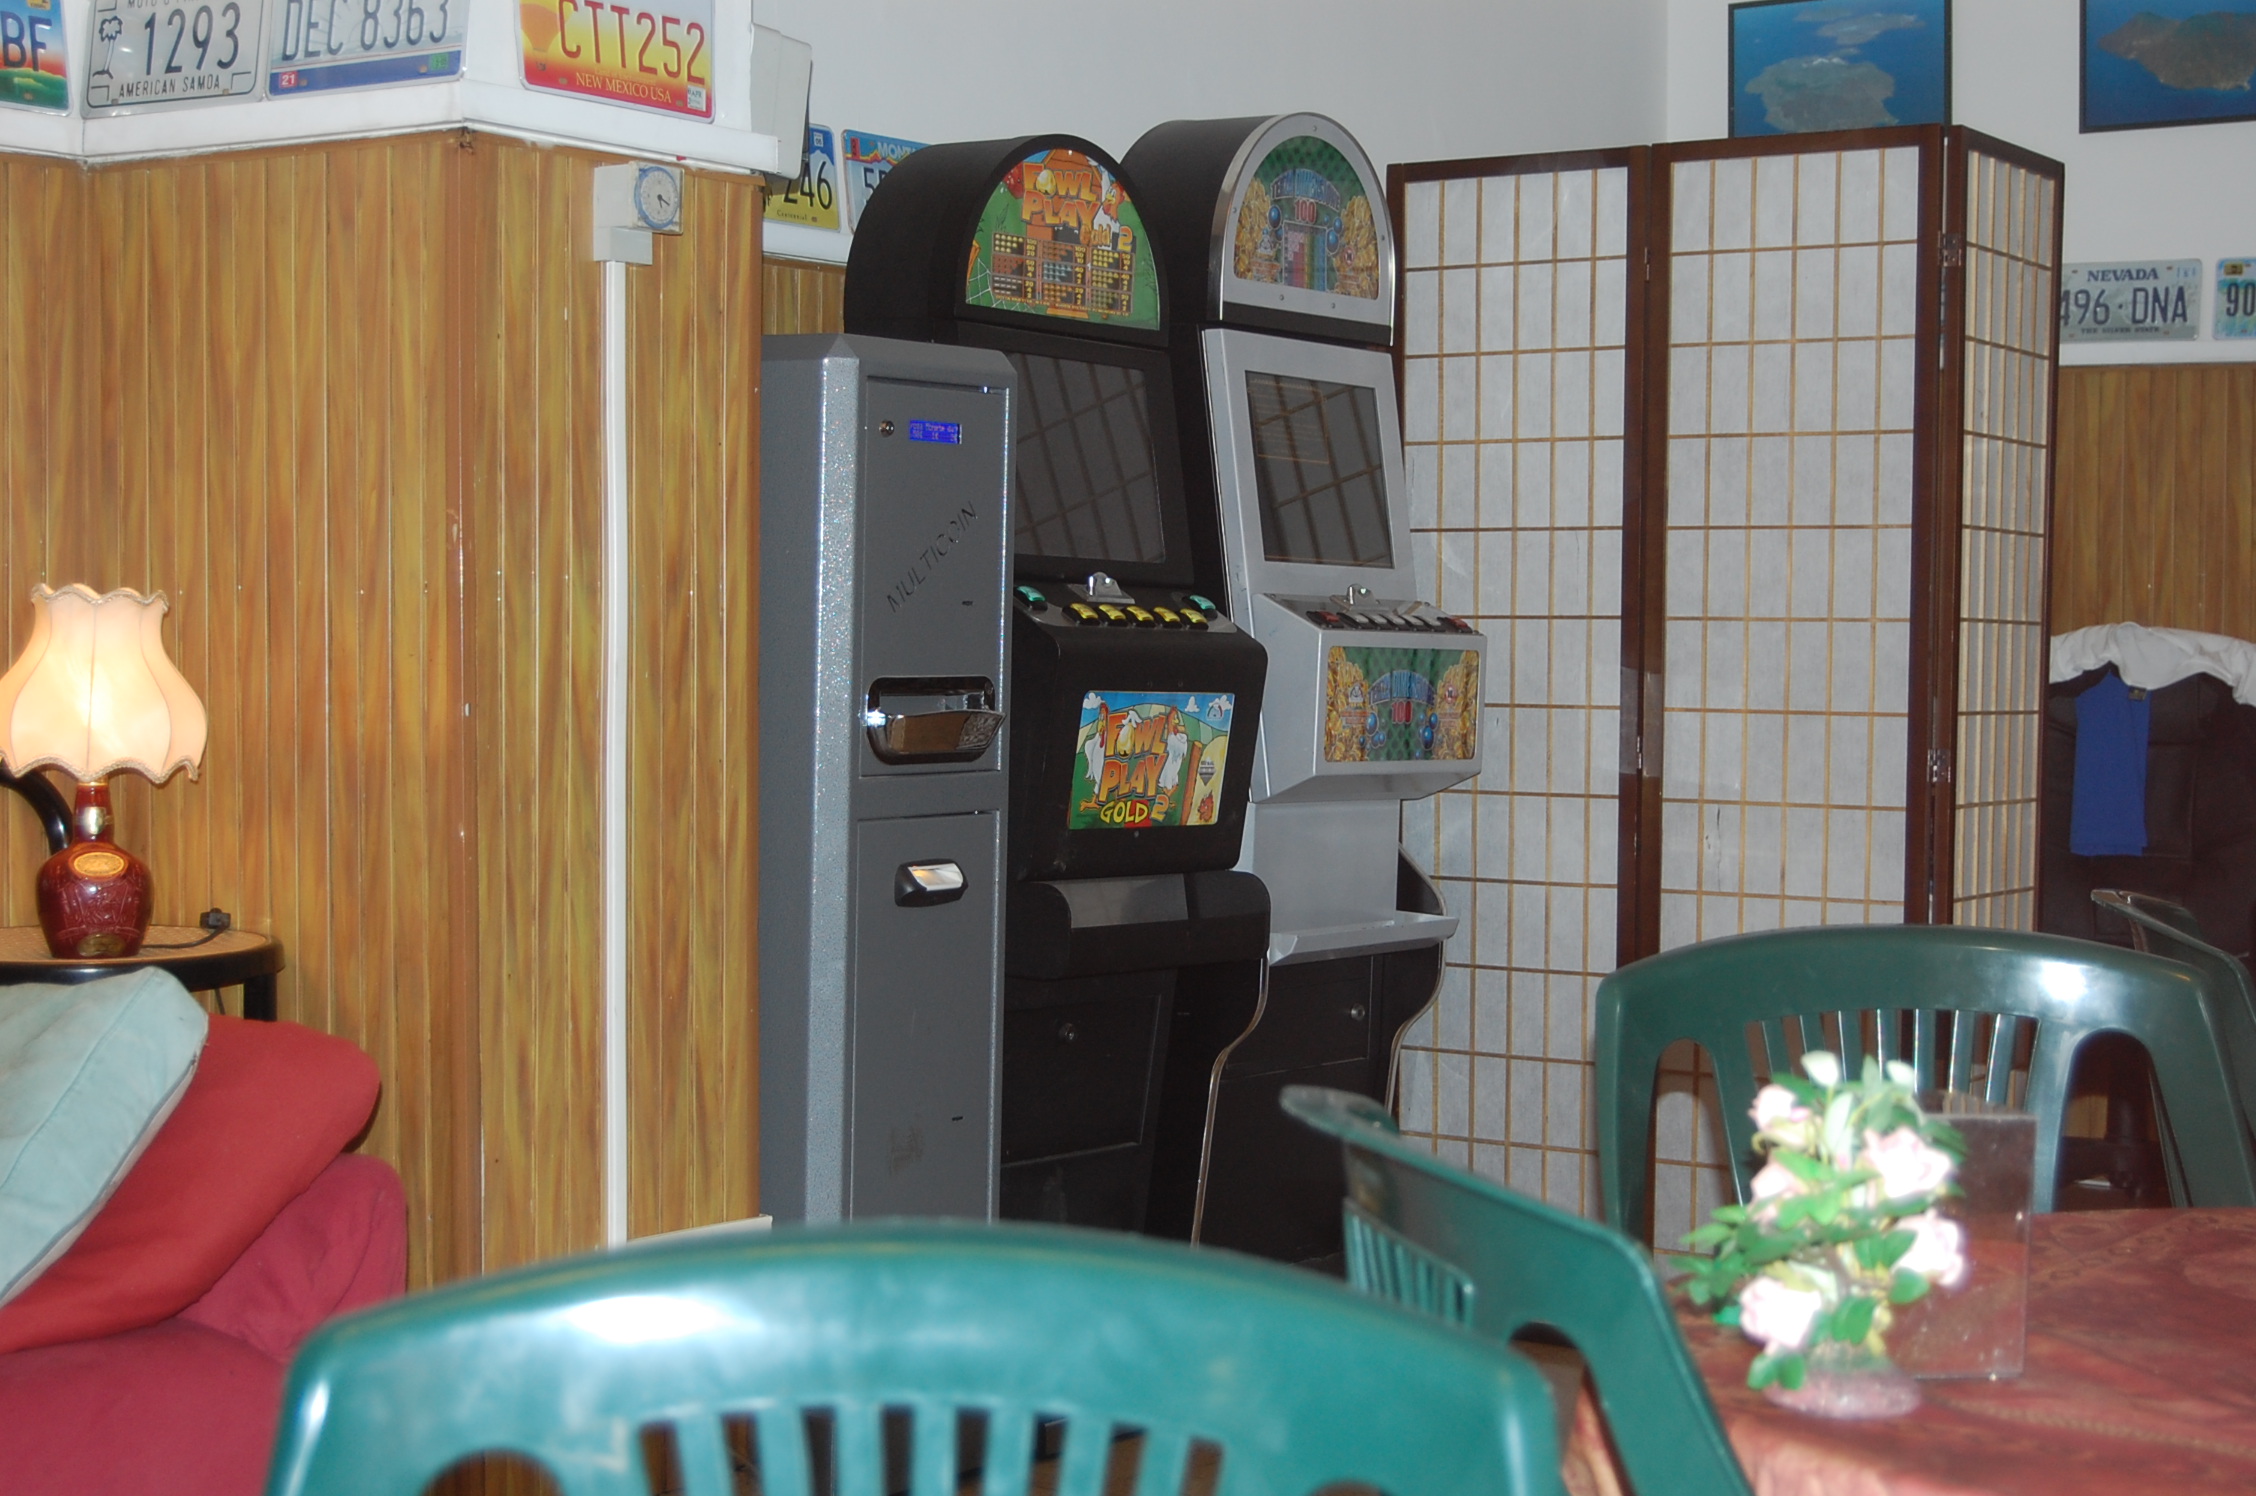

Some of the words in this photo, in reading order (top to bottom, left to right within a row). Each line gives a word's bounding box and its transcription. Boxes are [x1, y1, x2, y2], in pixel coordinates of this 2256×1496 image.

[144, 2, 241, 76] 1293
[282, 0, 345, 61] DEC
[360, 0, 449, 51] 8363
[558, 0, 706, 86] CTT252
[118, 79, 176, 99] AMERICAN
[182, 74, 220, 93] SAMOA
[281, 73, 296, 87] 21
[575, 72, 603, 89] NEW
[605, 78, 649, 99] MEXICO
[650, 86, 672, 104] USA
[1023, 163, 1097, 203] FOWL
[1022, 189, 1101, 231] PLAY
[1294, 199, 1317, 225] 100
[1117, 226, 1133, 251] 2
[2087, 267, 2160, 283] NEVADA
[887, 500, 977, 613] MULTICOIN
[1392, 701, 1413, 724] 100
[1105, 711, 1168, 758] FOWL
[1098, 753, 1169, 805] PLAY
[1100, 800, 1148, 824] GOLD
[1150, 794, 1169, 823] 2
